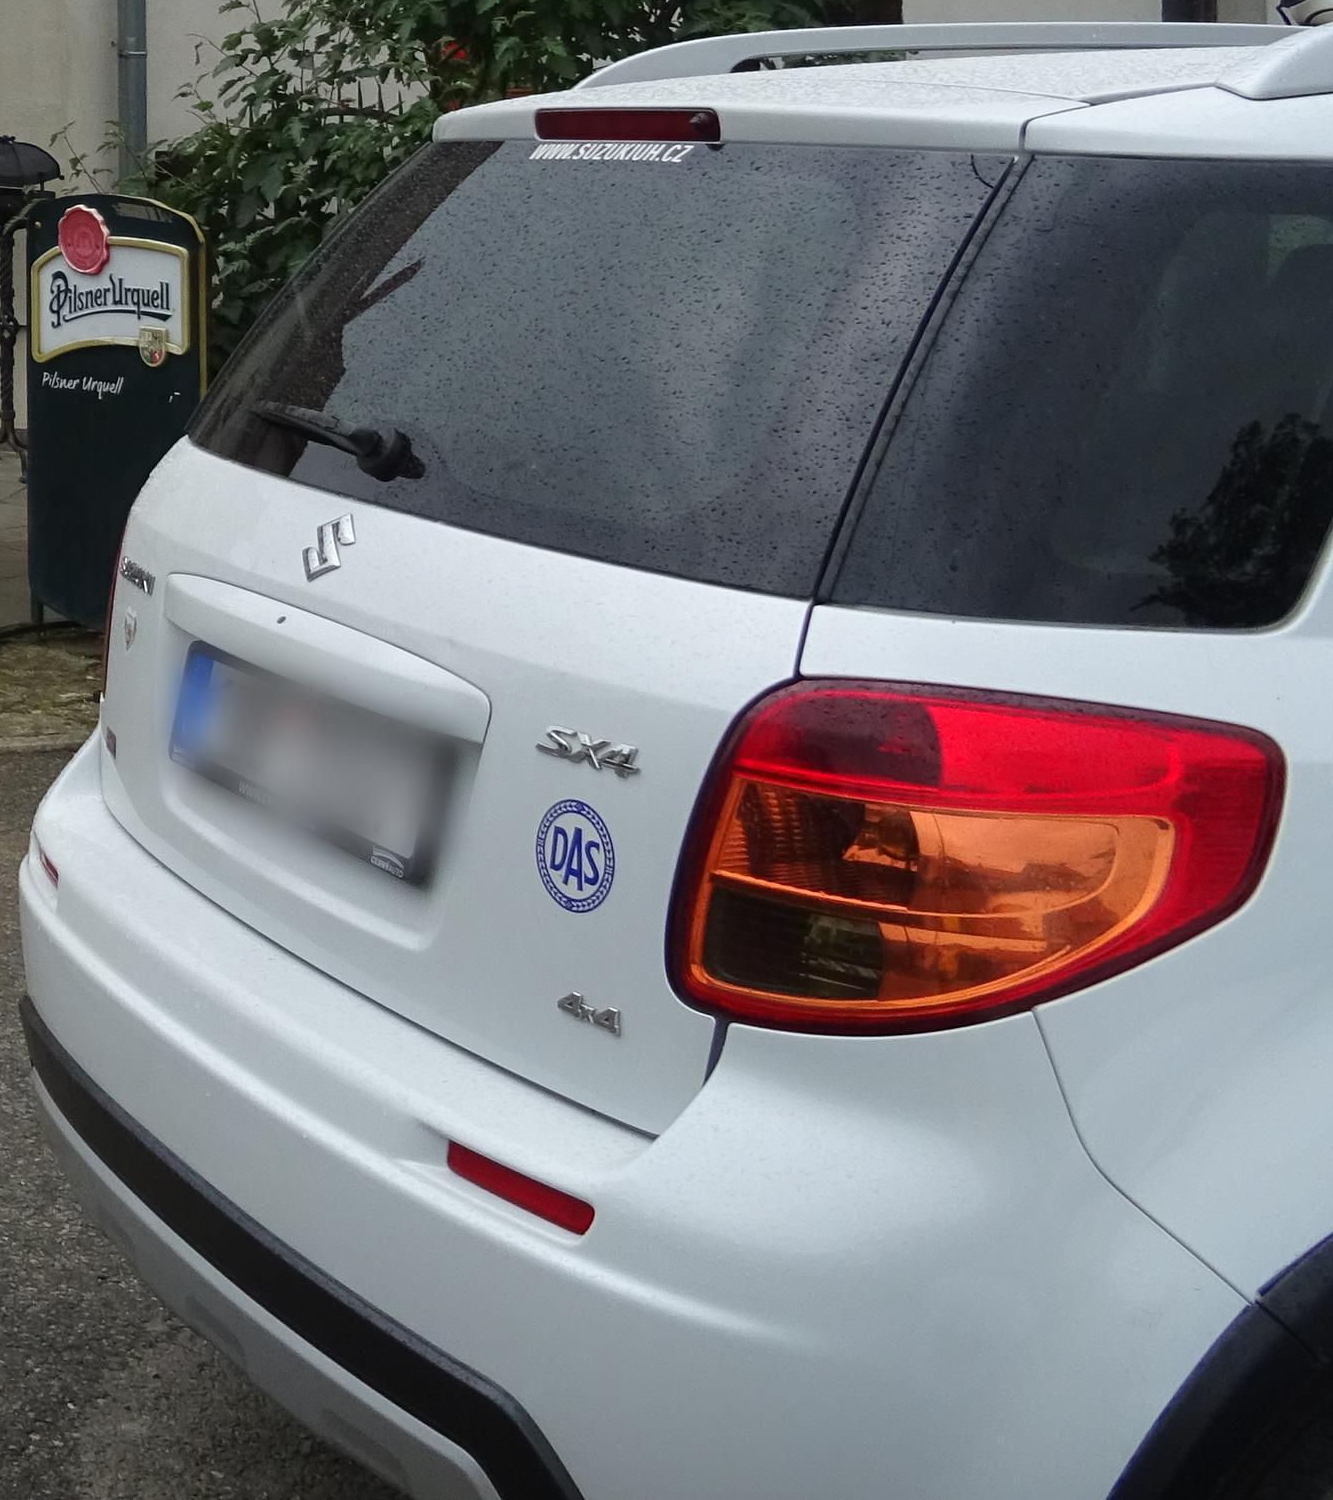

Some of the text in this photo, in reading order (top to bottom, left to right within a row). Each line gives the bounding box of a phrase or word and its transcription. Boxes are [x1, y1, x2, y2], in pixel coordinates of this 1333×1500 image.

[529, 143, 695, 163] WWW.SUZUKIUH.CZ
[48, 270, 171, 329] Pilsner Urquell
[42, 371, 124, 400] Pilsner Urquell
[535, 724, 642, 780] SX4
[549, 824, 601, 892] DAS
[557, 991, 622, 1038] 4x4
